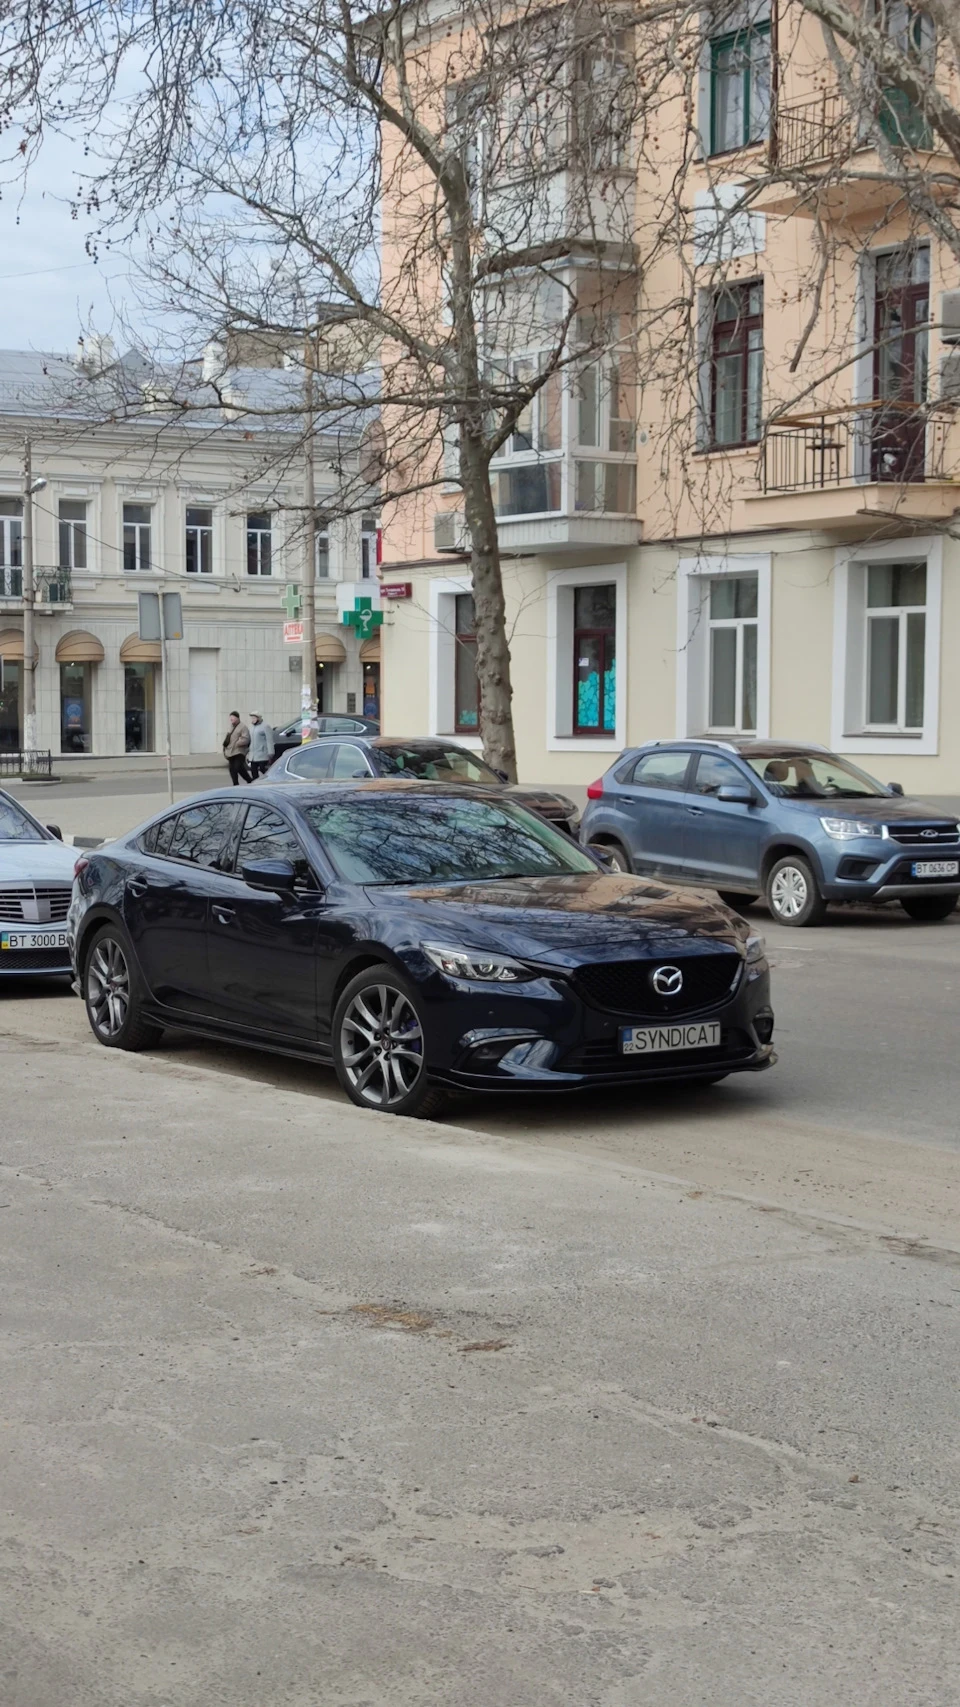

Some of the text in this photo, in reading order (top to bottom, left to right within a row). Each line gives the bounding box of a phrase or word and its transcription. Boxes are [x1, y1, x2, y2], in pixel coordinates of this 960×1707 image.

[916, 862, 956, 874] BT 0636 CP
[10, 935, 27, 947] BT
[30, 934, 56, 947] 3000
[58, 934, 68, 946] B
[635, 1023, 720, 1050] SYNDICAT
[623, 1043, 634, 1052] 22
